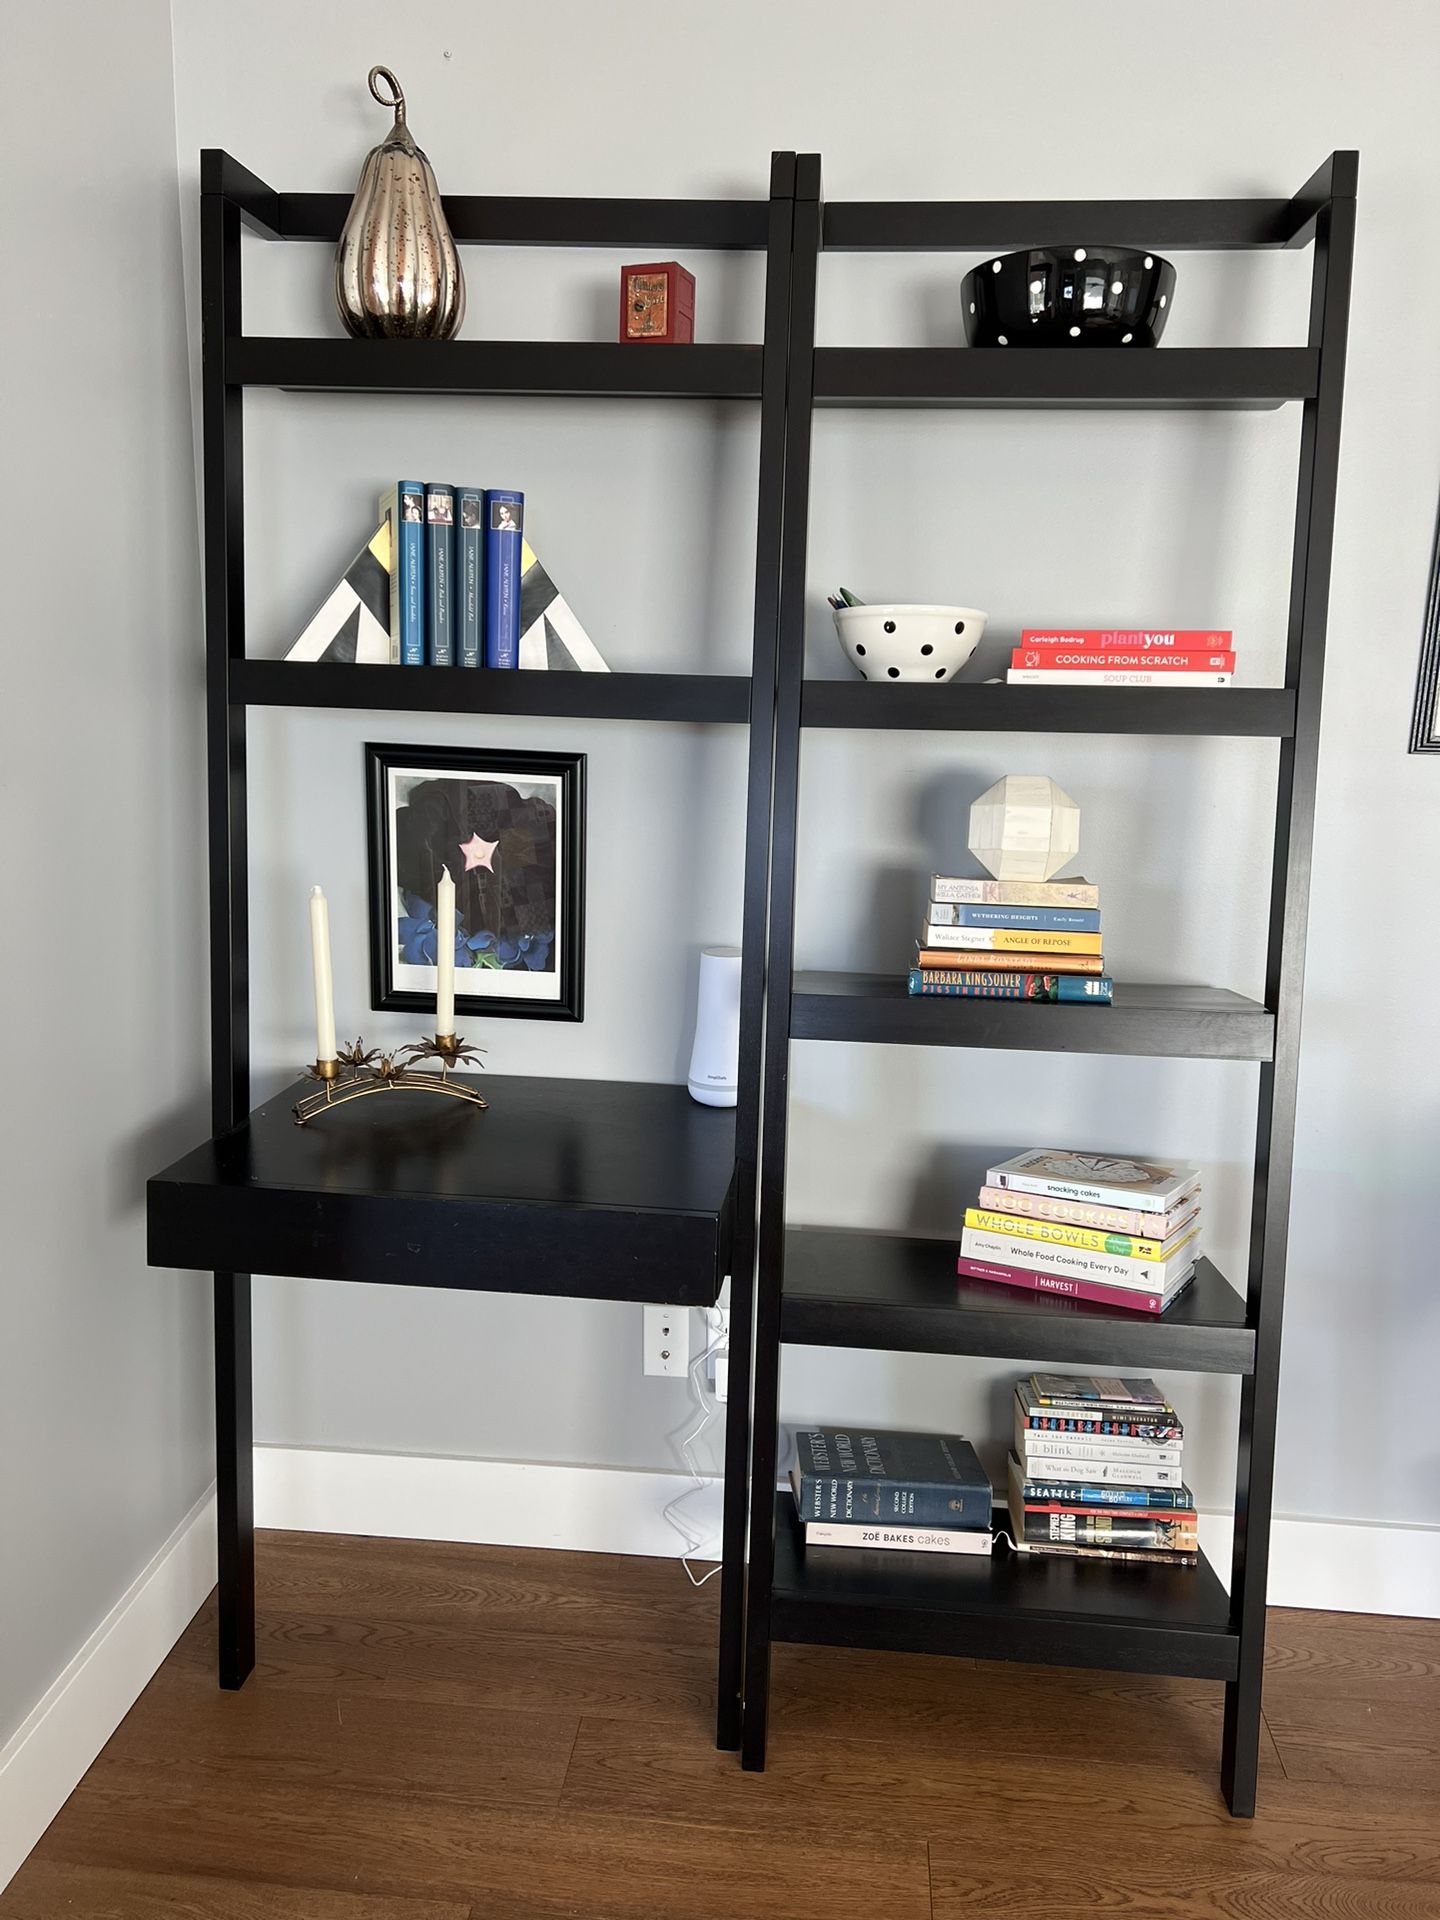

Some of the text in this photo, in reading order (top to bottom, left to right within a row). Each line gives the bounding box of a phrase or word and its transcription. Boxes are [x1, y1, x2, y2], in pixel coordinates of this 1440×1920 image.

[1030, 635, 1085, 645] Carleigh Bodrug
[1055, 655, 1189, 665] COOKING FROM SCRATCH
[1104, 674, 1152, 683] SOUP CLUB
[971, 912, 1010, 920] WUTHERING
[935, 933, 985, 943] Wallace Stegner
[1003, 937, 1029, 945] ANGLE
[1043, 938, 1072, 946] REPOSE
[922, 970, 1021, 988] BARBARA KINGSOLVER
[922, 984, 1020, 996] PIGS IN HEAVEN
[1047, 1184, 1079, 1197] snacking
[1080, 1188, 1101, 1198] cakes
[994, 1192, 1033, 1212] 100
[1038, 1201, 1129, 1230] COOKIES
[976, 1213, 1100, 1247] WHOLE BOWLS
[975, 1241, 984, 1249] Amy
[1010, 1247, 1129, 1276] Whole Food Cooking Every Day
[1040, 1277, 1073, 1293] HARVEST
[808, 1433, 832, 1471] WEBSTER'S
[835, 1434, 857, 1473] NEW WORLD
[862, 1436, 886, 1475] DICTIONARY
[1043, 1444, 1072, 1455] blink
[1070, 1466, 1084, 1474] Dog
[814, 1479, 822, 1517] WEBSTER'S
[830, 1479, 838, 1503] WORLD
[1030, 1487, 1076, 1499] SEATTLE
[1049, 1513, 1060, 1541] STEPHEN
[1060, 1513, 1076, 1541] KING
[862, 1532, 951, 1546] ZOË BAKES cakes
